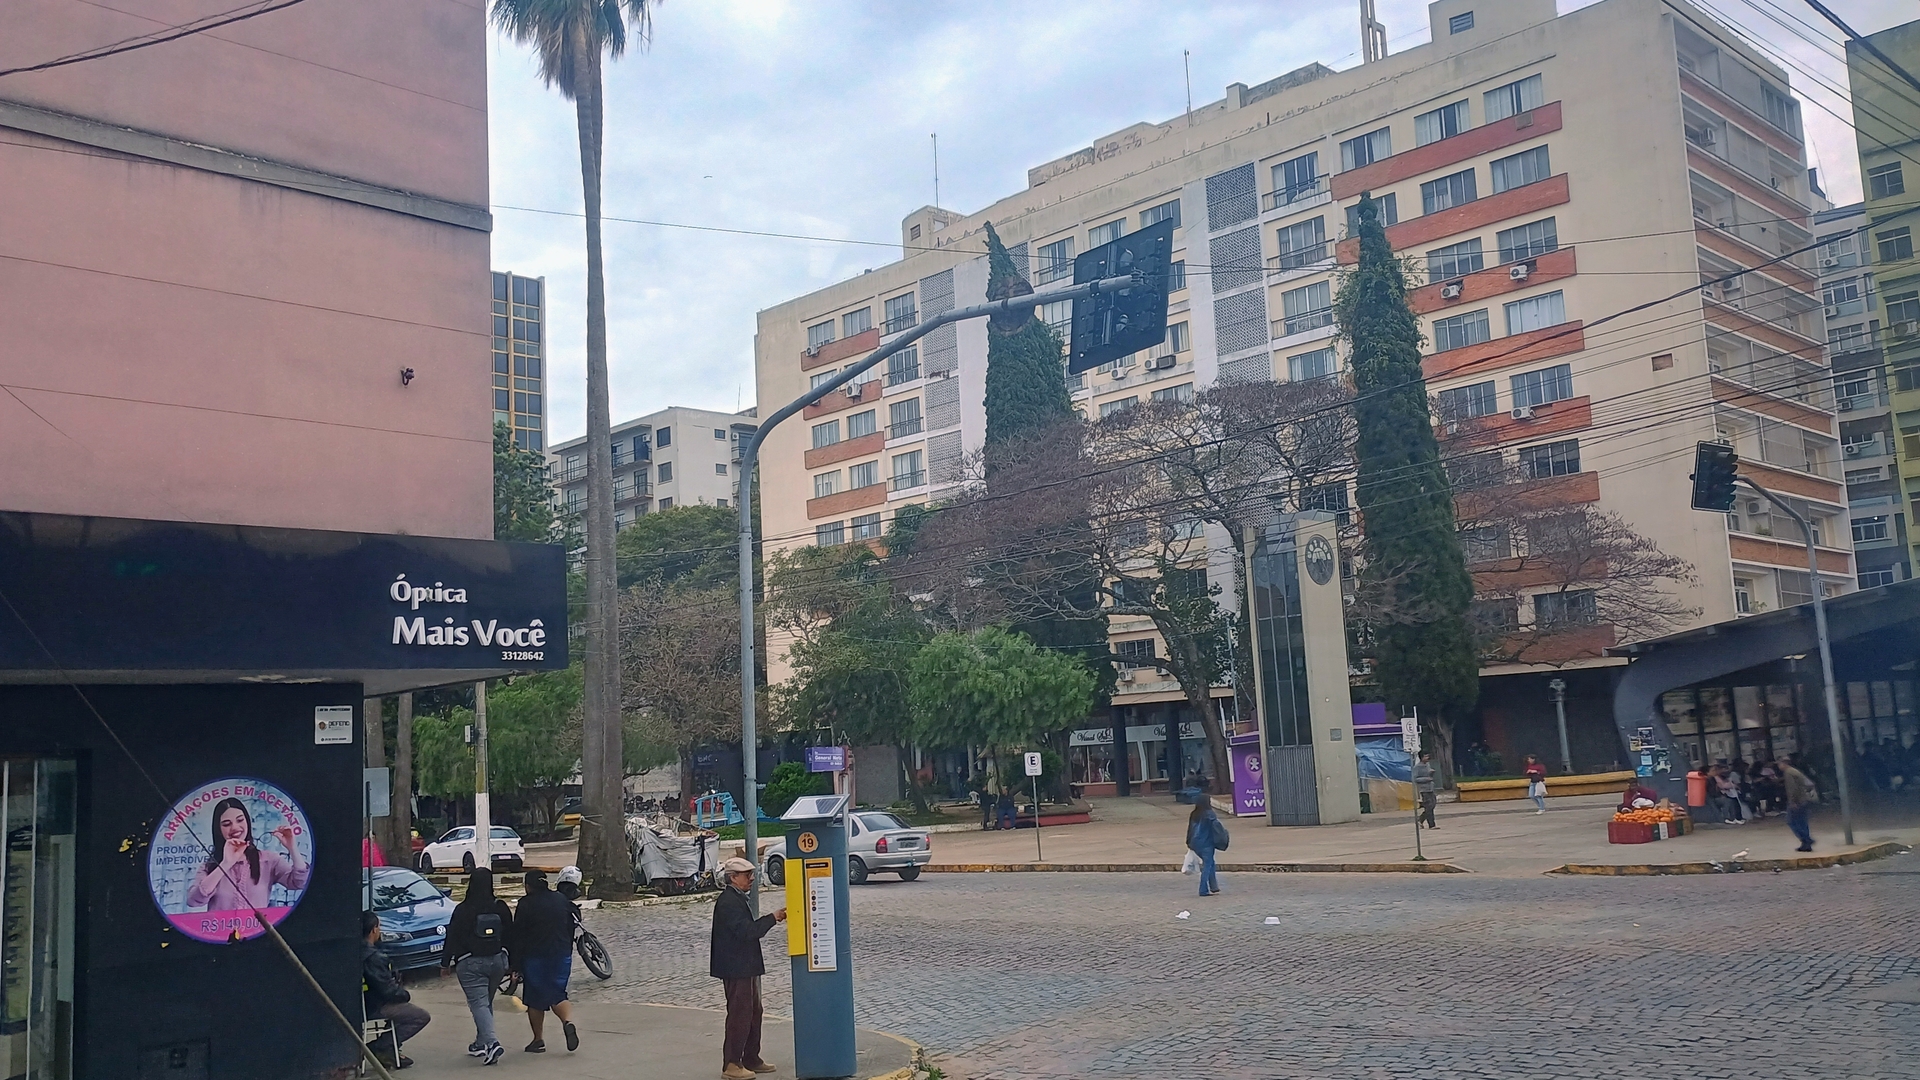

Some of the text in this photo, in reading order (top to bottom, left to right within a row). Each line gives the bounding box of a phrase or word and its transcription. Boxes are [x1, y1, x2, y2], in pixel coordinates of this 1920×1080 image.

[392, 616, 546, 647] Mais Você
[501, 651, 544, 661] 33128642
[1030, 756, 1036, 765] E
[1244, 796, 1265, 808] viv
[163, 785, 302, 841] ARMAÇÕES EM ACETATO
[801, 838, 814, 848] 19
[156, 854, 214, 866] IMPERDÍVE
